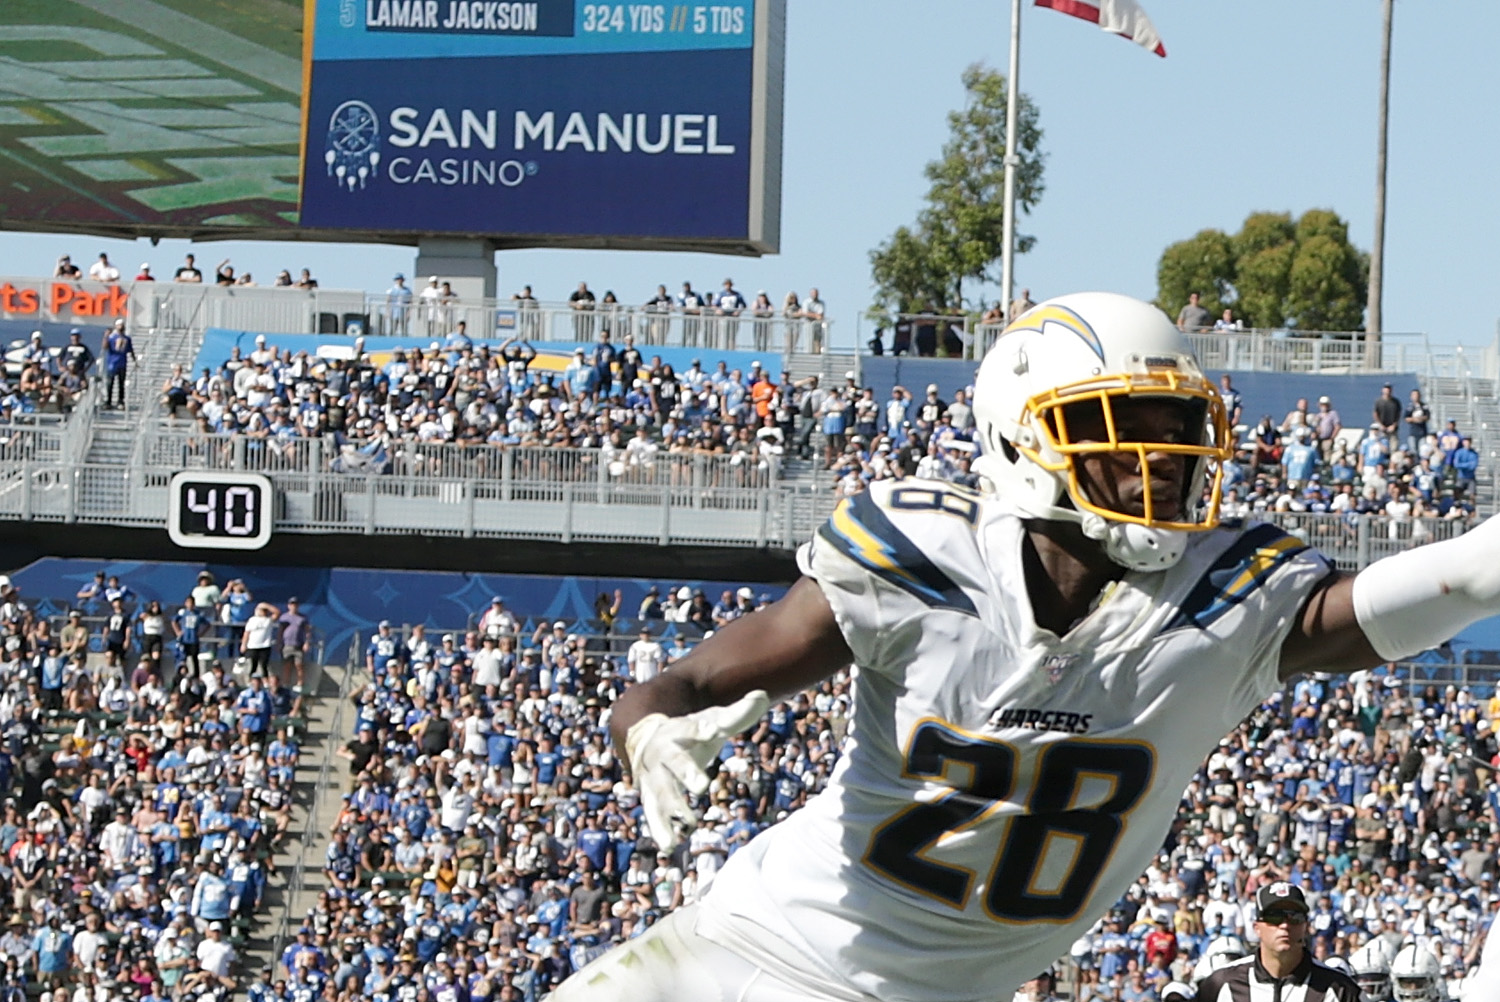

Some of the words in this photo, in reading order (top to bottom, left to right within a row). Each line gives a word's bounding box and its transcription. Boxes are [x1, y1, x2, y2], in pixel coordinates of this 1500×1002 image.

[366, 0, 438, 28] LAMAR
[443, 2, 538, 31] JACKSON
[583, 4, 625, 33] 324
[629, 5, 665, 33] YDS
[693, 6, 708, 34] 5
[710, 6, 745, 35] TDS
[388, 107, 497, 150] SAN
[514, 110, 736, 154] MANUEL
[51, 283, 130, 317] Park
[303, 410, 319, 428] 13
[187, 486, 254, 535] 40
[988, 706, 1094, 734] CHARGERS
[862, 718, 1158, 924] 28
